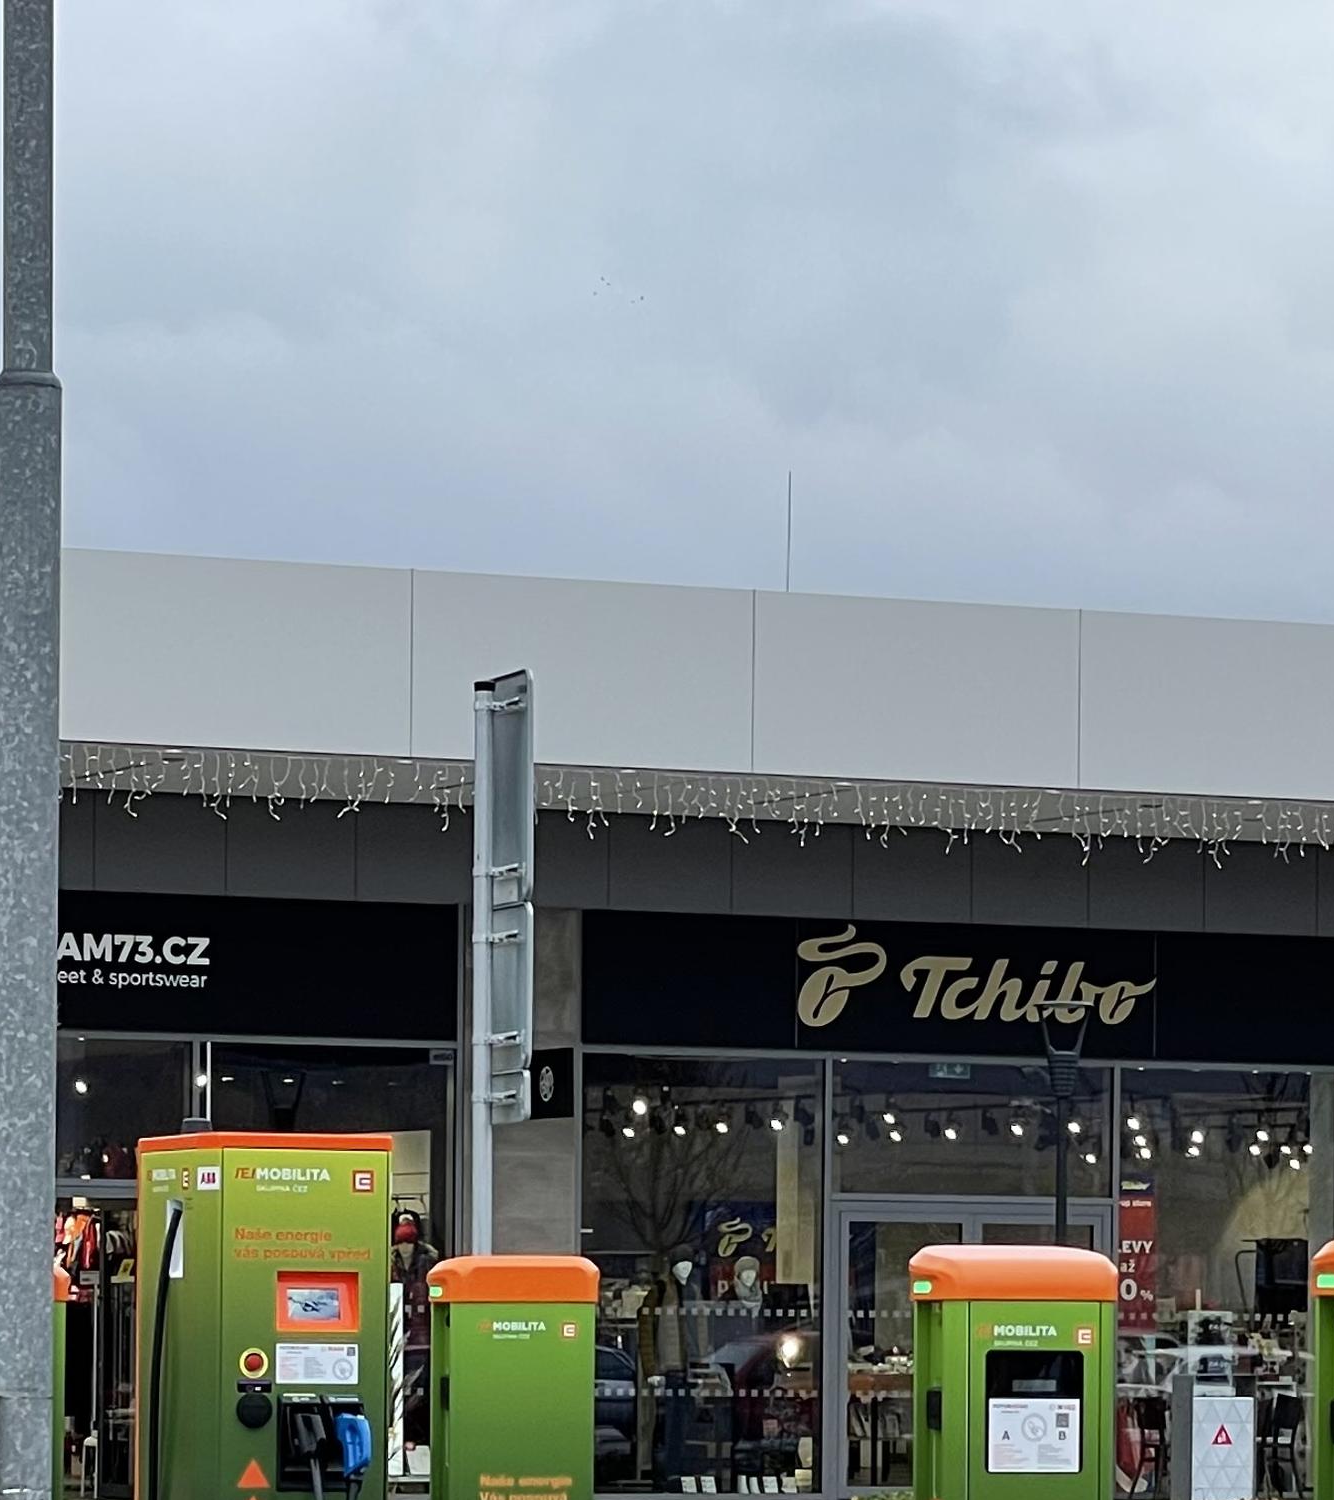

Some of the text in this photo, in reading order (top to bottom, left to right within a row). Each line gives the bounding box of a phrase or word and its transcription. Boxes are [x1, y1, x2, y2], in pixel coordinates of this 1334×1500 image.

[57, 932, 210, 965] AM73.CZ
[57, 968, 208, 989] eet & sportswear
[899, 955, 1157, 1025] Tchibo
[276, 1229, 332, 1244] energie
[1118, 1240, 1153, 1254] EVY
[1120, 1278, 1138, 1301] 0
